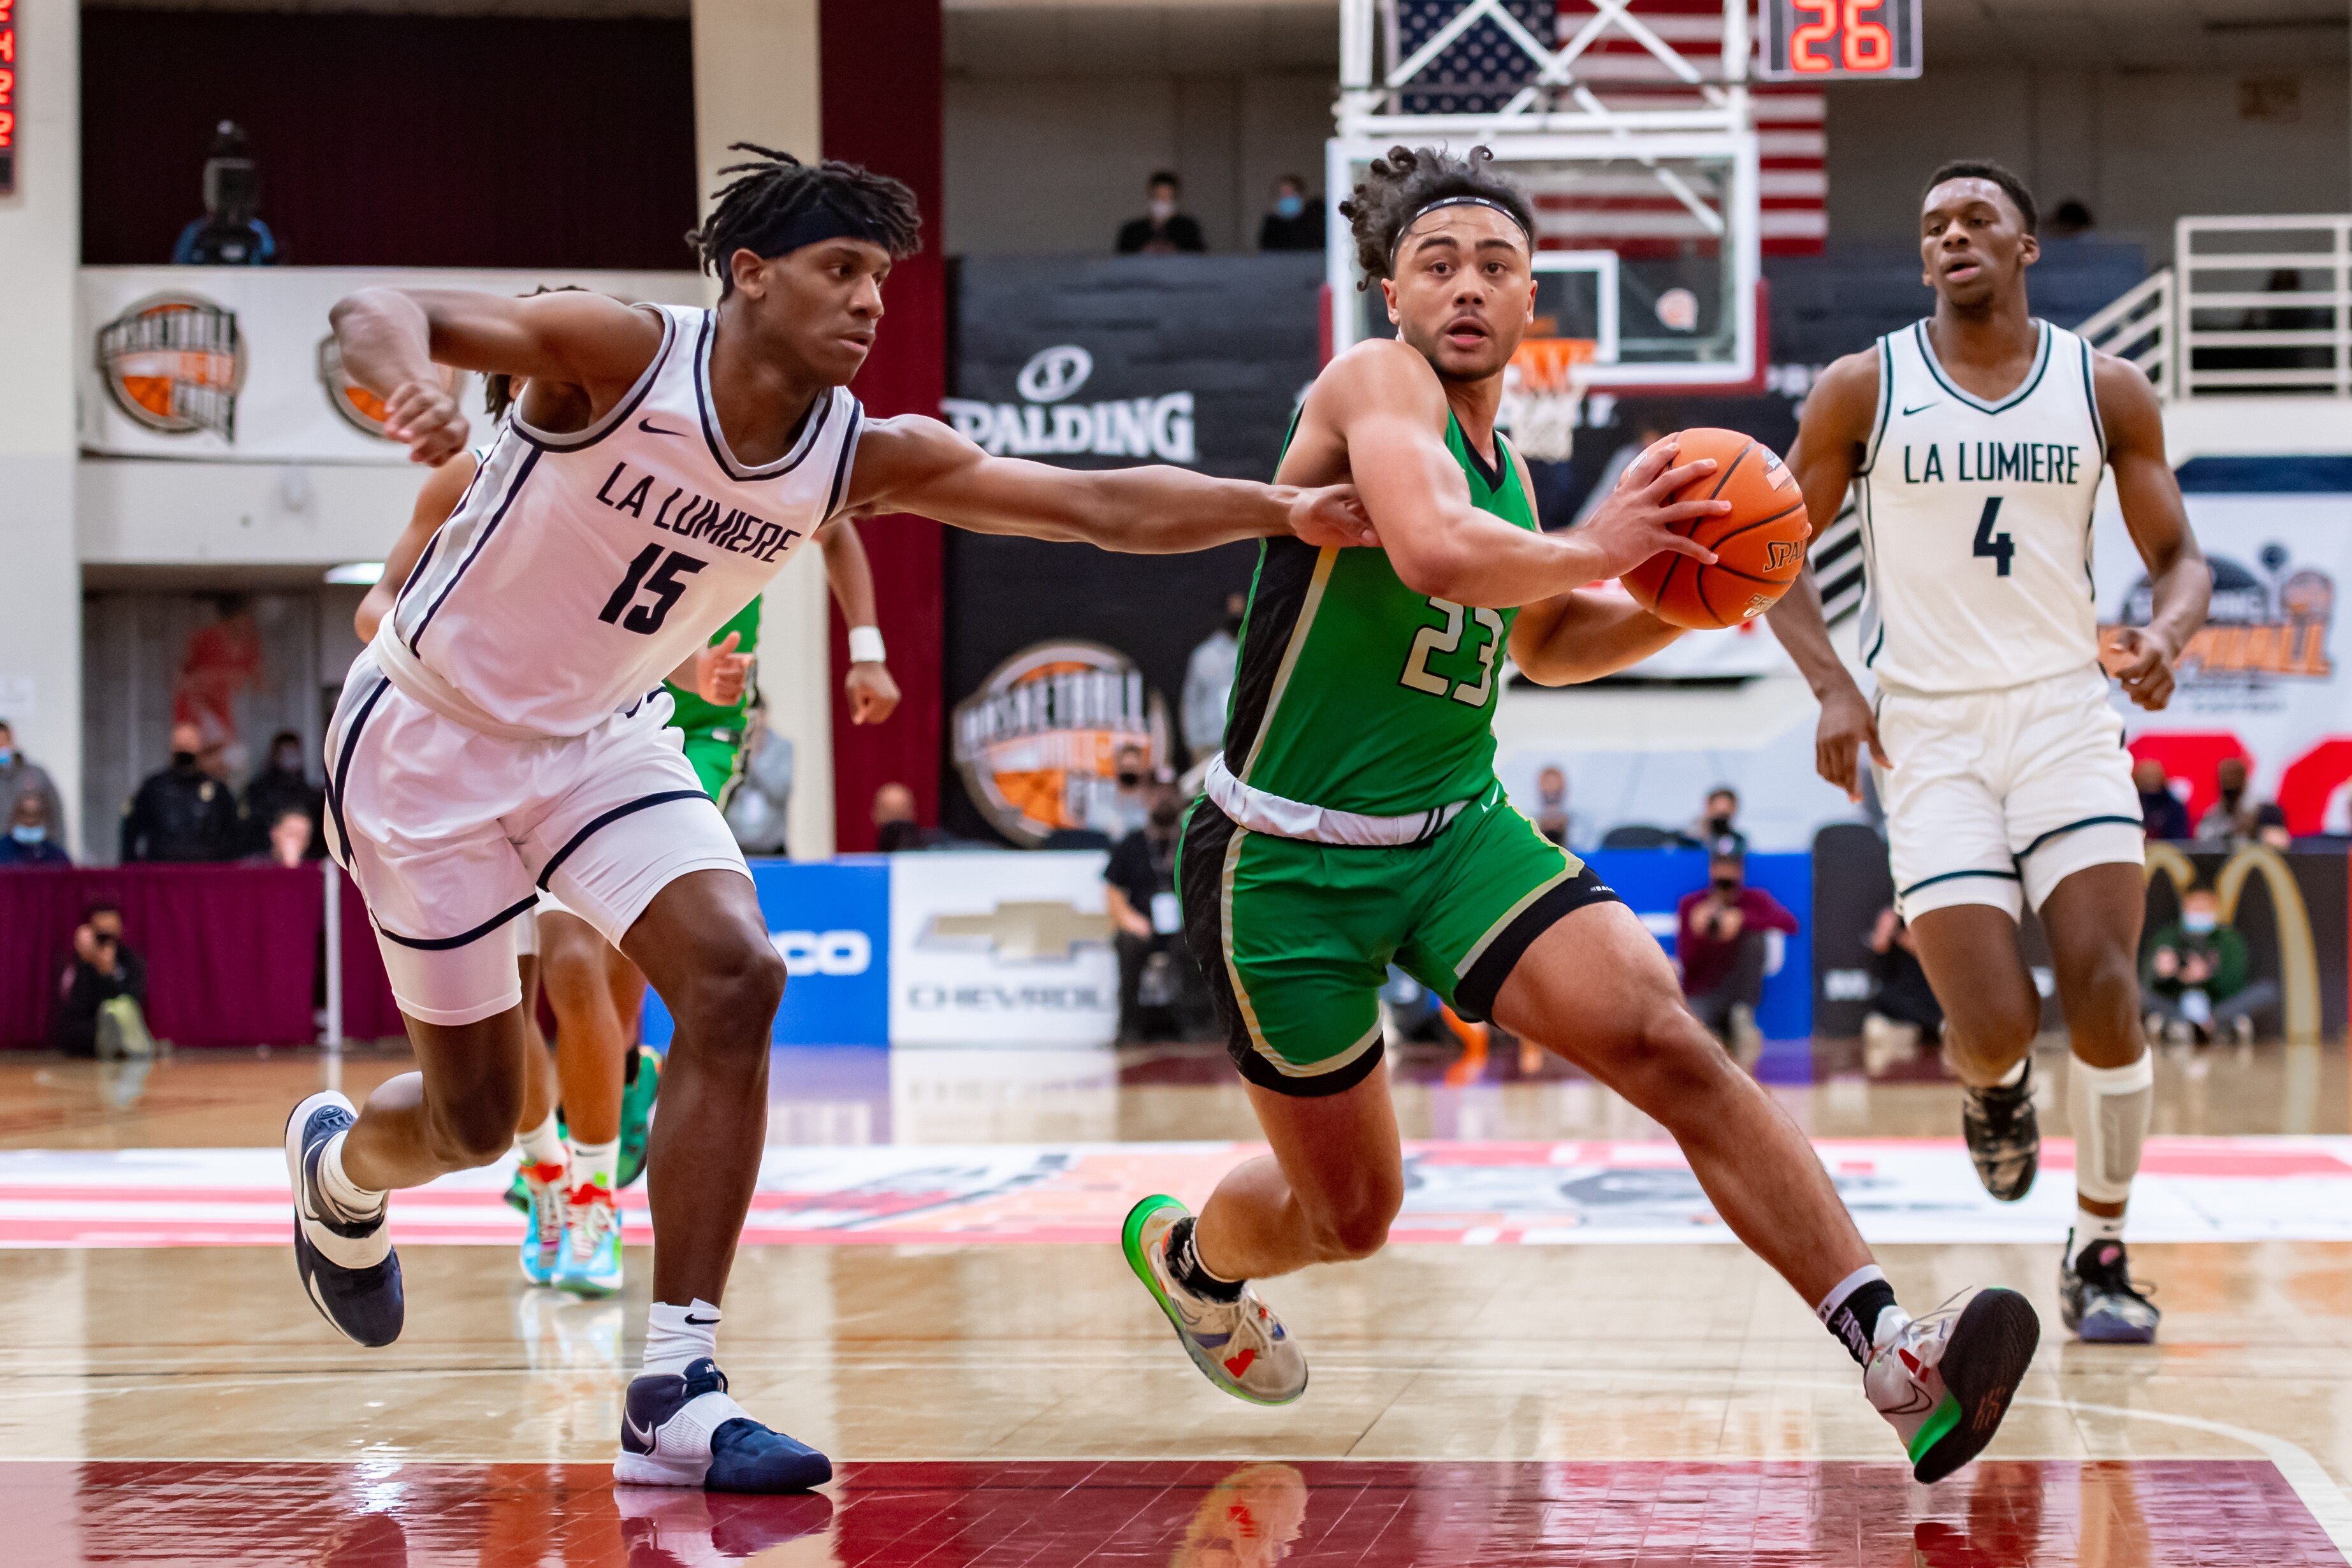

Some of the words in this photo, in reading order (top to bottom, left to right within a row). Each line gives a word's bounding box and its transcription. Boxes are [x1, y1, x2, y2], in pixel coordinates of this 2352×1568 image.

[1789, 0, 1892, 73] 26
[1905, 444, 1944, 484] LA
[1959, 442, 2080, 484] LUMIERE
[595, 461, 656, 519] LA
[653, 487, 802, 563] LUMIERE
[1973, 497, 2015, 577] 4
[597, 541, 709, 635] 15
[1397, 596, 1506, 710] 23
